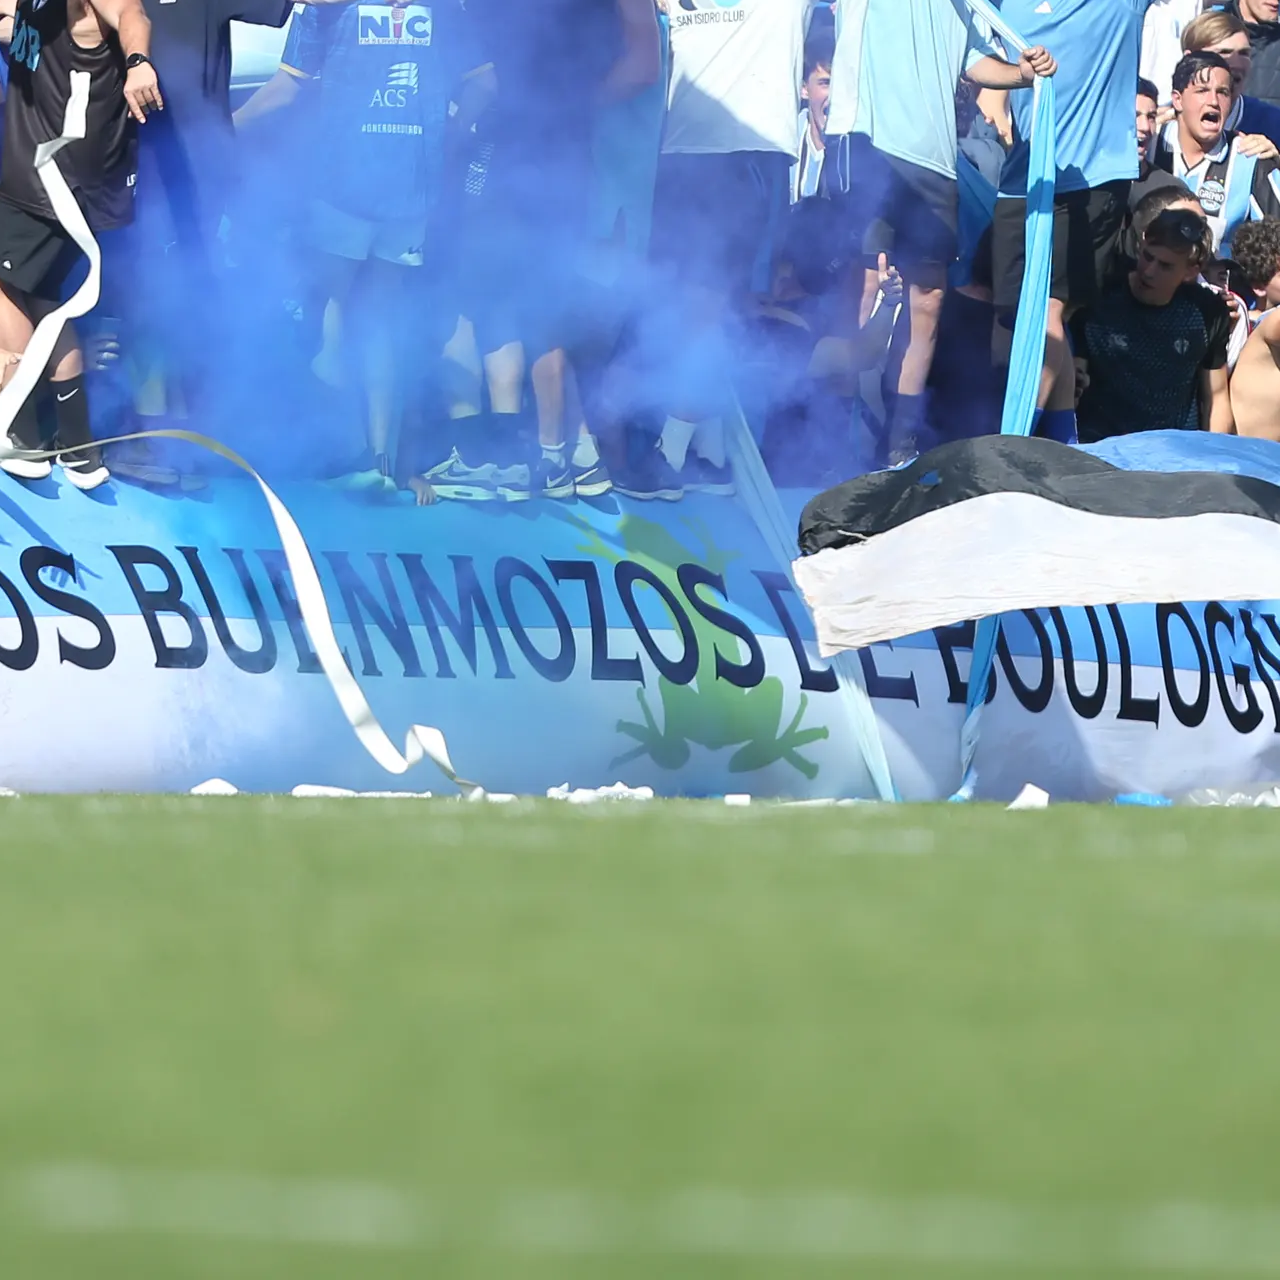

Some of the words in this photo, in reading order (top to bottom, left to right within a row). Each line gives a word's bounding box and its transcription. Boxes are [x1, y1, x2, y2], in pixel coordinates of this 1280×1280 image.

[676, 14, 693, 27] SAN
[694, 11, 721, 25] ISIDRO
[722, 9, 745, 23] CLUB
[368, 88, 407, 108] ACS
[108, 543, 767, 688] BUENMOZOS
